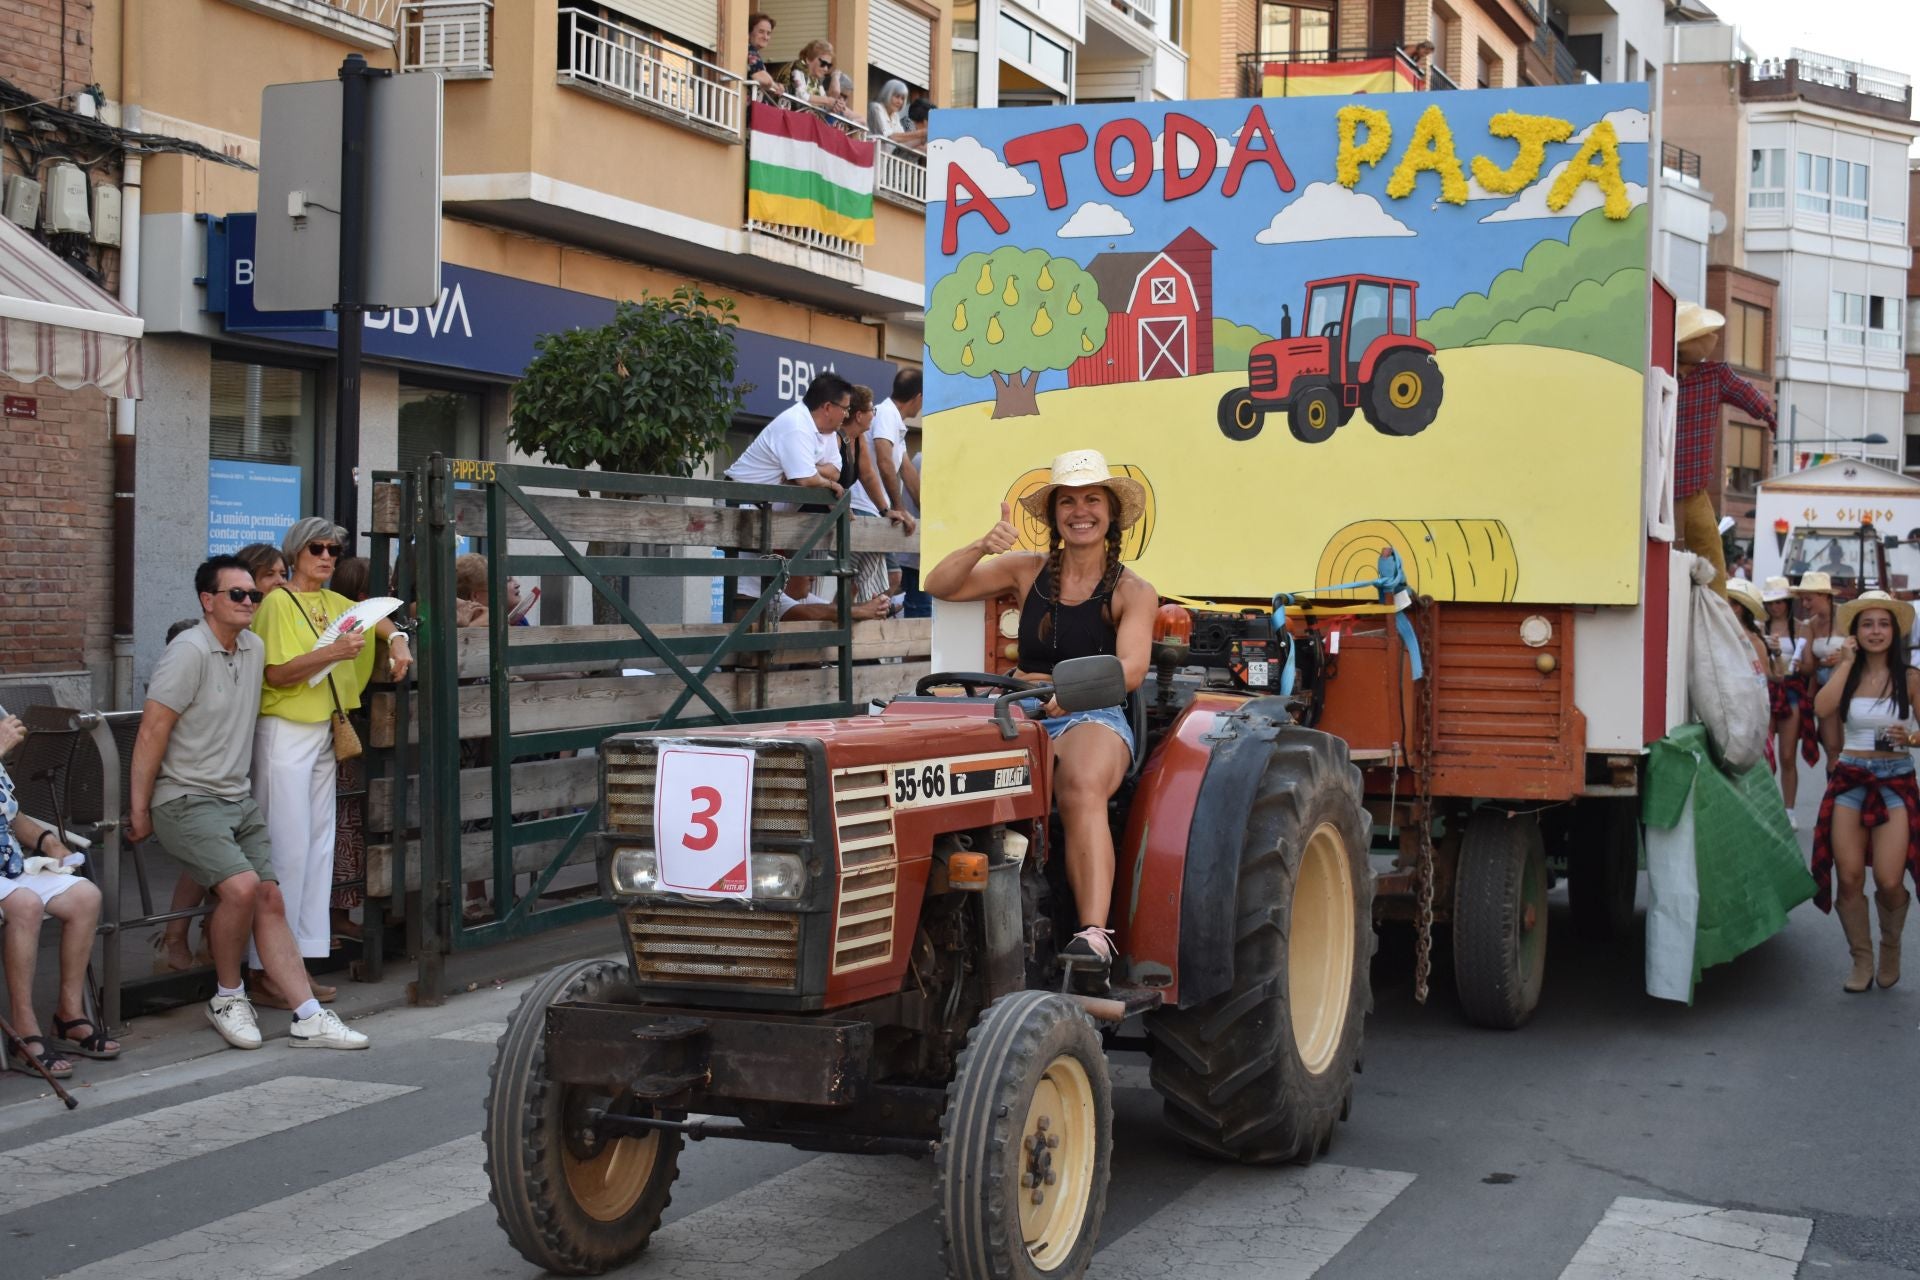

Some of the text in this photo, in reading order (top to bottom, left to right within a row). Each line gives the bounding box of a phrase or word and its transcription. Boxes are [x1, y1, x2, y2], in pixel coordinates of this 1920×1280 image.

[941, 104, 1632, 255] A TODA PAJA
[778, 356, 835, 402] BB
[209, 528, 275, 541] contar con una
[210, 511, 222, 524] La
[223, 511, 250, 526] unión
[895, 764, 945, 803] 55-66
[994, 767, 1024, 788] FIAT
[682, 785, 722, 852] 3
